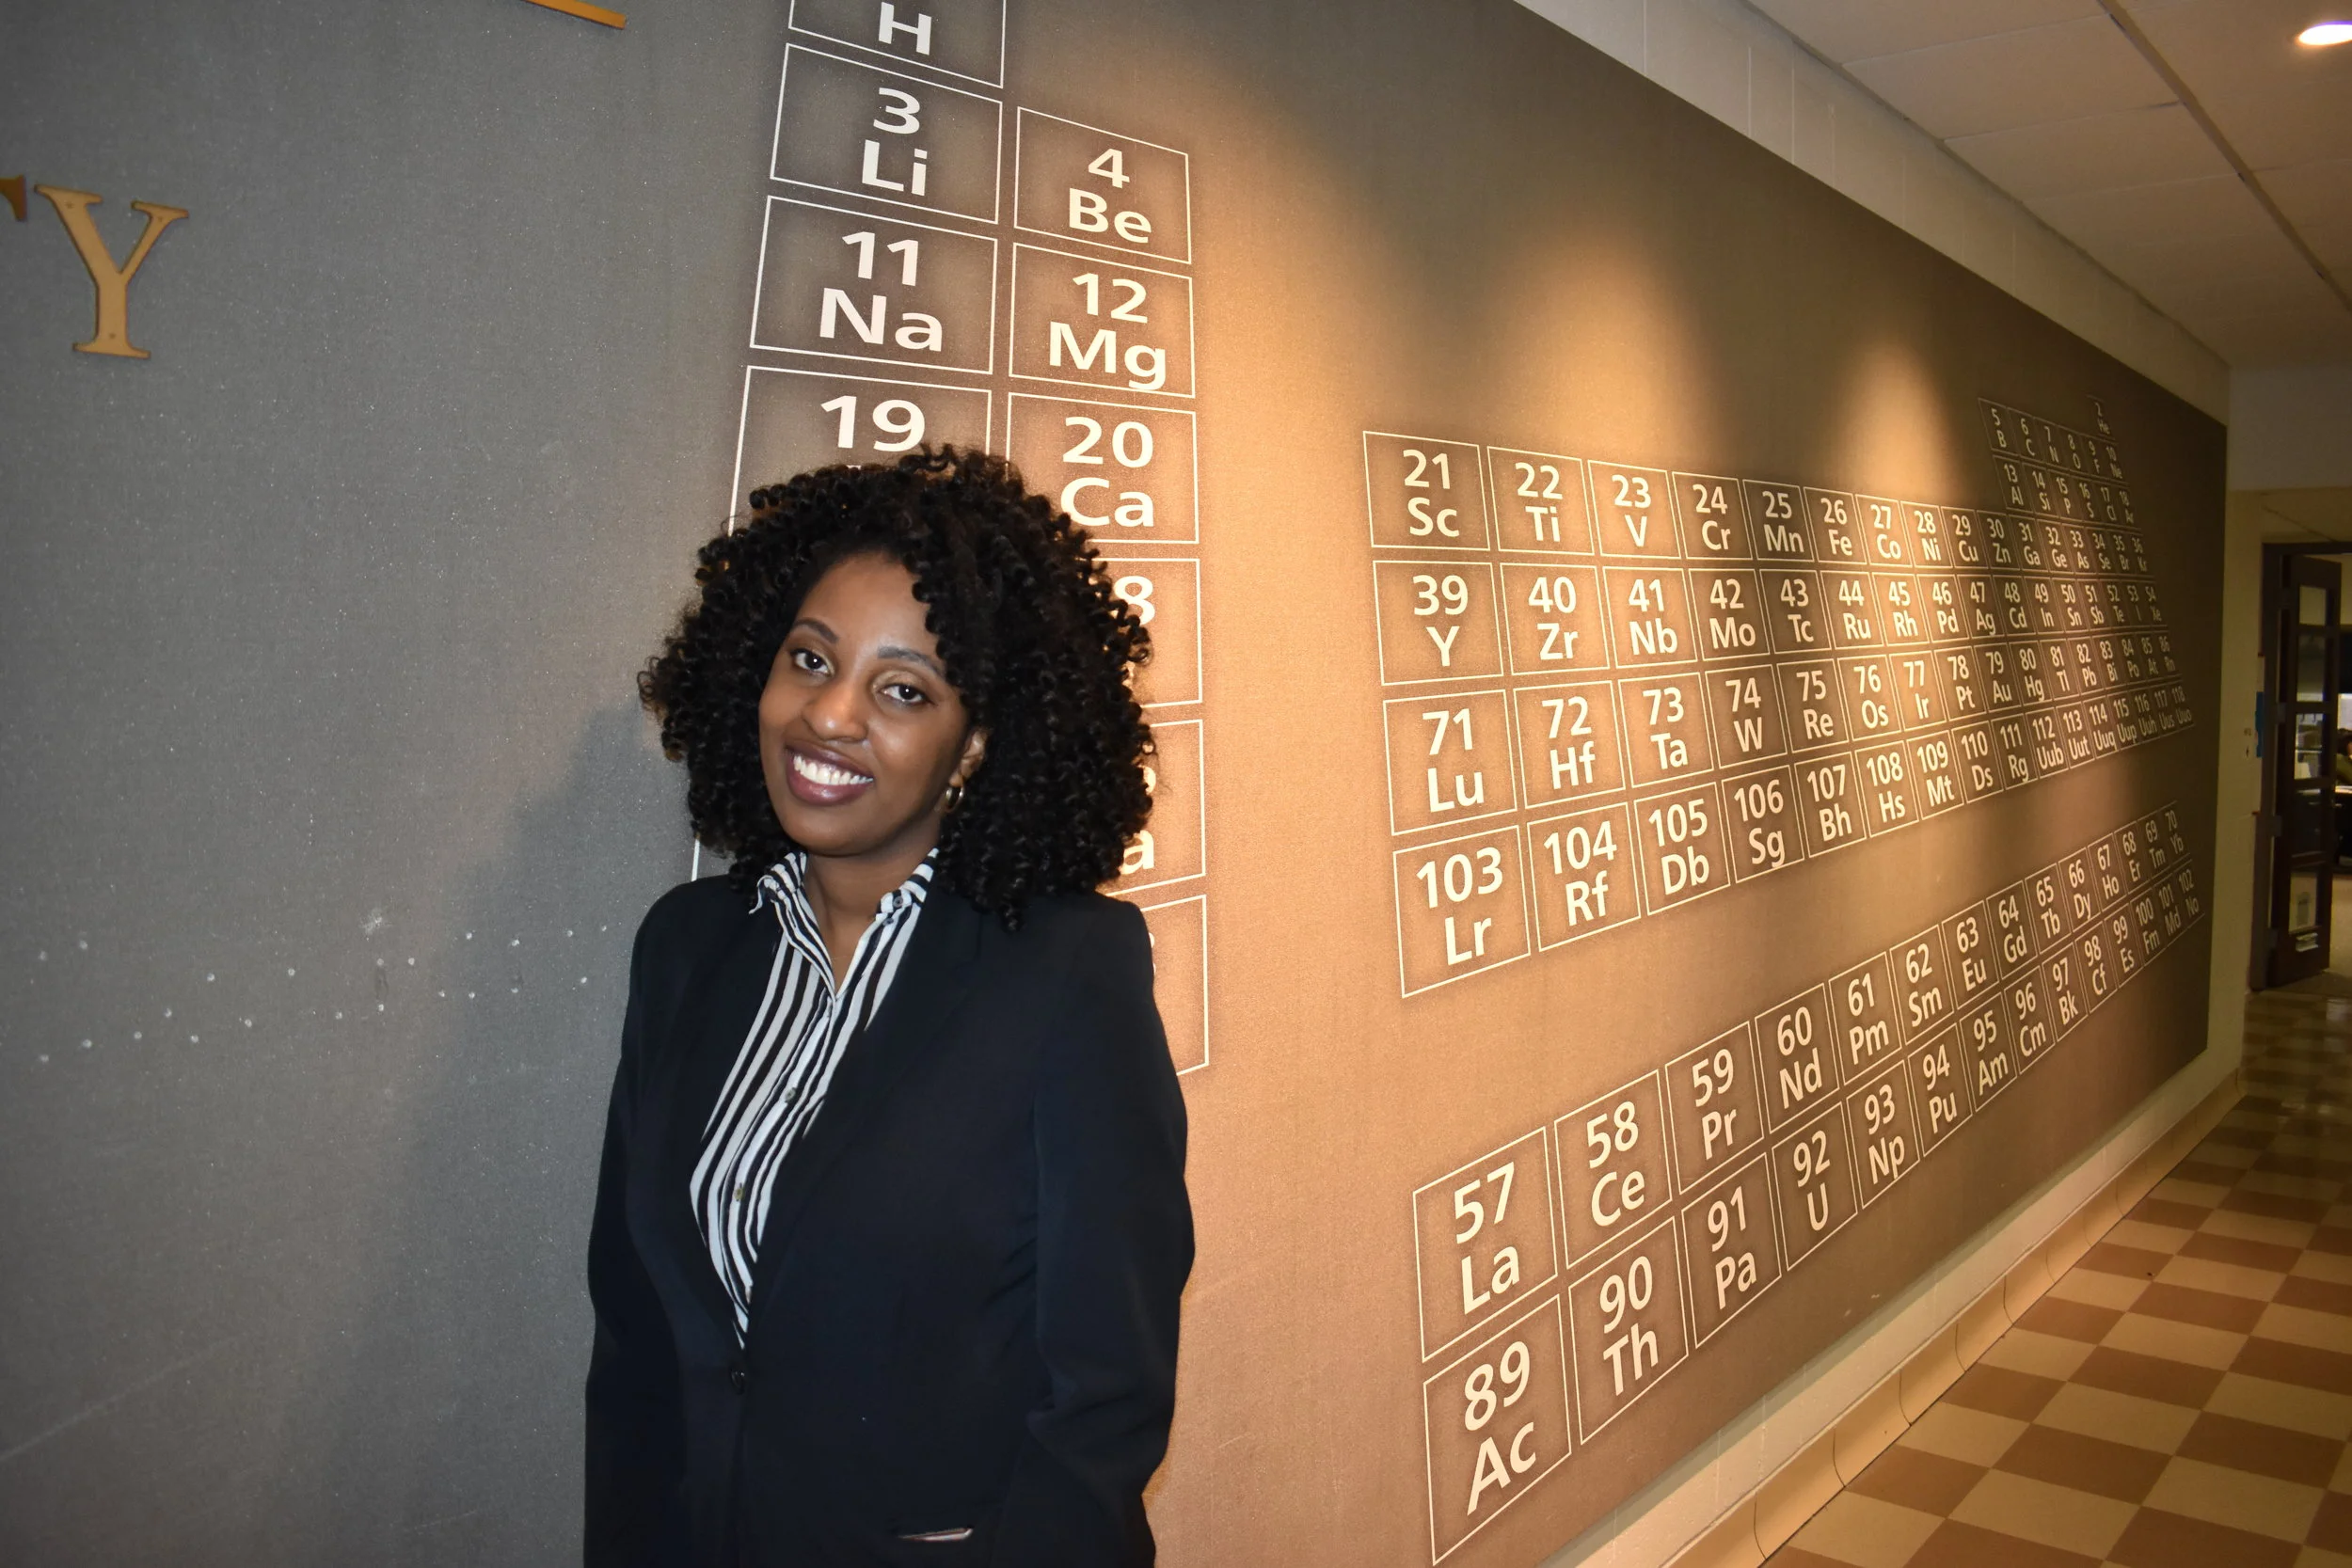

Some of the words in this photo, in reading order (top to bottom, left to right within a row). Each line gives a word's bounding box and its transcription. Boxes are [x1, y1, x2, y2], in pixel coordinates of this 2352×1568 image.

[879, 2, 931, 55] H
[873, 87, 920, 134] 3
[862, 140, 927, 196] Li
[1089, 149, 1130, 188] 4
[1069, 188, 1152, 244] Be
[842, 231, 918, 286] 11
[1073, 273, 1148, 324] 12
[820, 288, 942, 352] Na
[1049, 322, 1167, 390] Mg
[821, 396, 926, 451] 19
[1992, 408, 2002, 427] 5
[2021, 418, 2030, 436] 6
[1063, 417, 1153, 467] 20
[1996, 430, 2007, 448] B
[2026, 438, 2036, 456] C
[1403, 450, 1450, 489] 21
[1515, 462, 1563, 499] 22
[2004, 464, 2018, 483] 13
[2032, 470, 2045, 489] 14
[1060, 478, 1155, 528] Ca
[1612, 475, 1651, 508] 23
[1692, 483, 1728, 515] 24
[1762, 491, 1792, 519] 25
[2011, 486, 2024, 505] Al
[2039, 492, 2051, 511] Si
[1408, 498, 1460, 537] Sc
[1525, 506, 1560, 542] Ti
[1820, 498, 1847, 525] 26
[1870, 504, 1891, 530] 27
[1914, 511, 1936, 534] 28
[1952, 515, 1971, 536] 29
[1987, 517, 2005, 539] 30
[1625, 515, 1647, 546] V
[1702, 520, 1731, 550] Cr
[1764, 524, 1804, 552] Mn
[1828, 530, 1852, 556] Fe
[1877, 534, 1901, 559] Co
[2018, 522, 2033, 542] 31
[2045, 526, 2061, 546] 32
[1921, 538, 1941, 561] Ni
[1959, 540, 1979, 562] Cu
[1993, 543, 2011, 563] Zn
[2024, 546, 2041, 565] Ga
[2052, 548, 2068, 568] Ge
[1413, 575, 1468, 615] 39
[1529, 577, 1576, 613] 40
[1629, 579, 1664, 611] 41
[1710, 578, 1744, 610] 42
[1781, 578, 1809, 607] 43
[1838, 580, 1865, 606] 44
[1889, 581, 1911, 606] 45
[1932, 581, 1952, 605] 46
[1970, 581, 1985, 603] 47
[2005, 582, 2021, 603] 48
[2035, 583, 2049, 603] 49
[1709, 617, 1756, 649] Mo
[1788, 614, 1814, 642] Tc
[1843, 612, 1871, 640] Ru
[1893, 610, 1918, 637] Rh
[1936, 609, 1960, 634] Pd
[1976, 609, 1995, 635] Ag
[2009, 606, 2027, 628] Cd
[2041, 608, 2055, 627] In
[1425, 626, 1460, 667] Y
[1537, 623, 1578, 660] Zr
[1629, 618, 1677, 656] Nb
[1947, 655, 1969, 680] 78
[1985, 651, 2004, 674] 79
[2019, 648, 2037, 671] 80
[2050, 646, 2064, 667] 81
[1796, 670, 1826, 702] 75
[1853, 664, 1881, 694] 76
[1903, 660, 1924, 688] 77
[2026, 676, 2044, 702] Hg
[2057, 670, 2071, 691] Tl
[1643, 687, 1684, 725] 73
[1725, 677, 1761, 712] 74
[1915, 693, 1929, 720] Ir
[1956, 686, 1976, 710] Pt
[1993, 680, 2012, 704] Au
[1542, 696, 1592, 738] 72
[1804, 709, 1834, 739] Re
[1862, 700, 1889, 729] Os
[2032, 716, 2056, 741] 112
[2063, 709, 2083, 733] 113
[2089, 703, 2107, 725] 114
[1422, 709, 1473, 755] 71
[1733, 717, 1762, 752] W
[1961, 731, 1988, 760] 110
[2000, 722, 2023, 750] 111
[1549, 741, 1596, 789] Hf
[1650, 733, 1688, 769] Ta
[1916, 741, 1948, 773] 109
[2037, 741, 2064, 769] Uub
[2068, 737, 2090, 761] Uut
[1807, 764, 1845, 802] 107
[1867, 752, 1903, 786] 108
[1971, 765, 1993, 791] Ds
[2009, 754, 2028, 783] Rg
[1427, 768, 1484, 813] Lu
[1734, 779, 1784, 822] 106
[1879, 791, 1905, 823] Hs
[1926, 775, 1955, 807] Mt
[1648, 799, 1708, 847] 105
[1820, 803, 1852, 841] Bh
[1544, 821, 1616, 875] 104
[1749, 828, 1785, 867] Sg
[1416, 847, 1502, 909] 103
[1661, 846, 1709, 895] Db
[1565, 870, 1608, 927] Rf
[2036, 876, 2054, 907] 65
[1998, 895, 2019, 928] 64
[2041, 909, 2060, 940] Tb
[1445, 916, 1491, 965] Lr
[1957, 917, 1979, 953] 63
[2004, 925, 2027, 963] Gd
[1906, 943, 1932, 983] 62
[1962, 958, 1987, 991] Eu
[2053, 957, 2068, 991] 97
[1848, 973, 1874, 1016] 61
[1909, 988, 1943, 1027] Sm
[2015, 982, 2036, 1021] 96
[2058, 990, 2078, 1025] Bk
[1777, 1006, 1812, 1055] 60
[1850, 1021, 1889, 1065] Pm
[1974, 1009, 1996, 1052] 95
[2020, 1022, 2046, 1056] Cm
[1692, 1049, 1733, 1107] 59
[1779, 1047, 1822, 1109] Nd
[1923, 1044, 1950, 1091] 94
[1979, 1053, 2009, 1096] Am
[1865, 1085, 1895, 1135] 93
[1929, 1086, 1960, 1129] Pu
[1587, 1101, 1638, 1169] 58
[1702, 1109, 1737, 1160] Pr
[1793, 1131, 1830, 1188] 92
[1868, 1136, 1905, 1184] Np
[1455, 1162, 1515, 1243] 57
[1592, 1171, 1645, 1226] Ce
[1807, 1182, 1828, 1230] U
[1708, 1186, 1746, 1252] 91
[1461, 1245, 1519, 1315] La
[1600, 1256, 1652, 1334] 90
[1715, 1252, 1756, 1309] Pa
[1603, 1323, 1659, 1396] Th
[1465, 1341, 1530, 1431] 89
[1467, 1422, 1536, 1515] Ac
